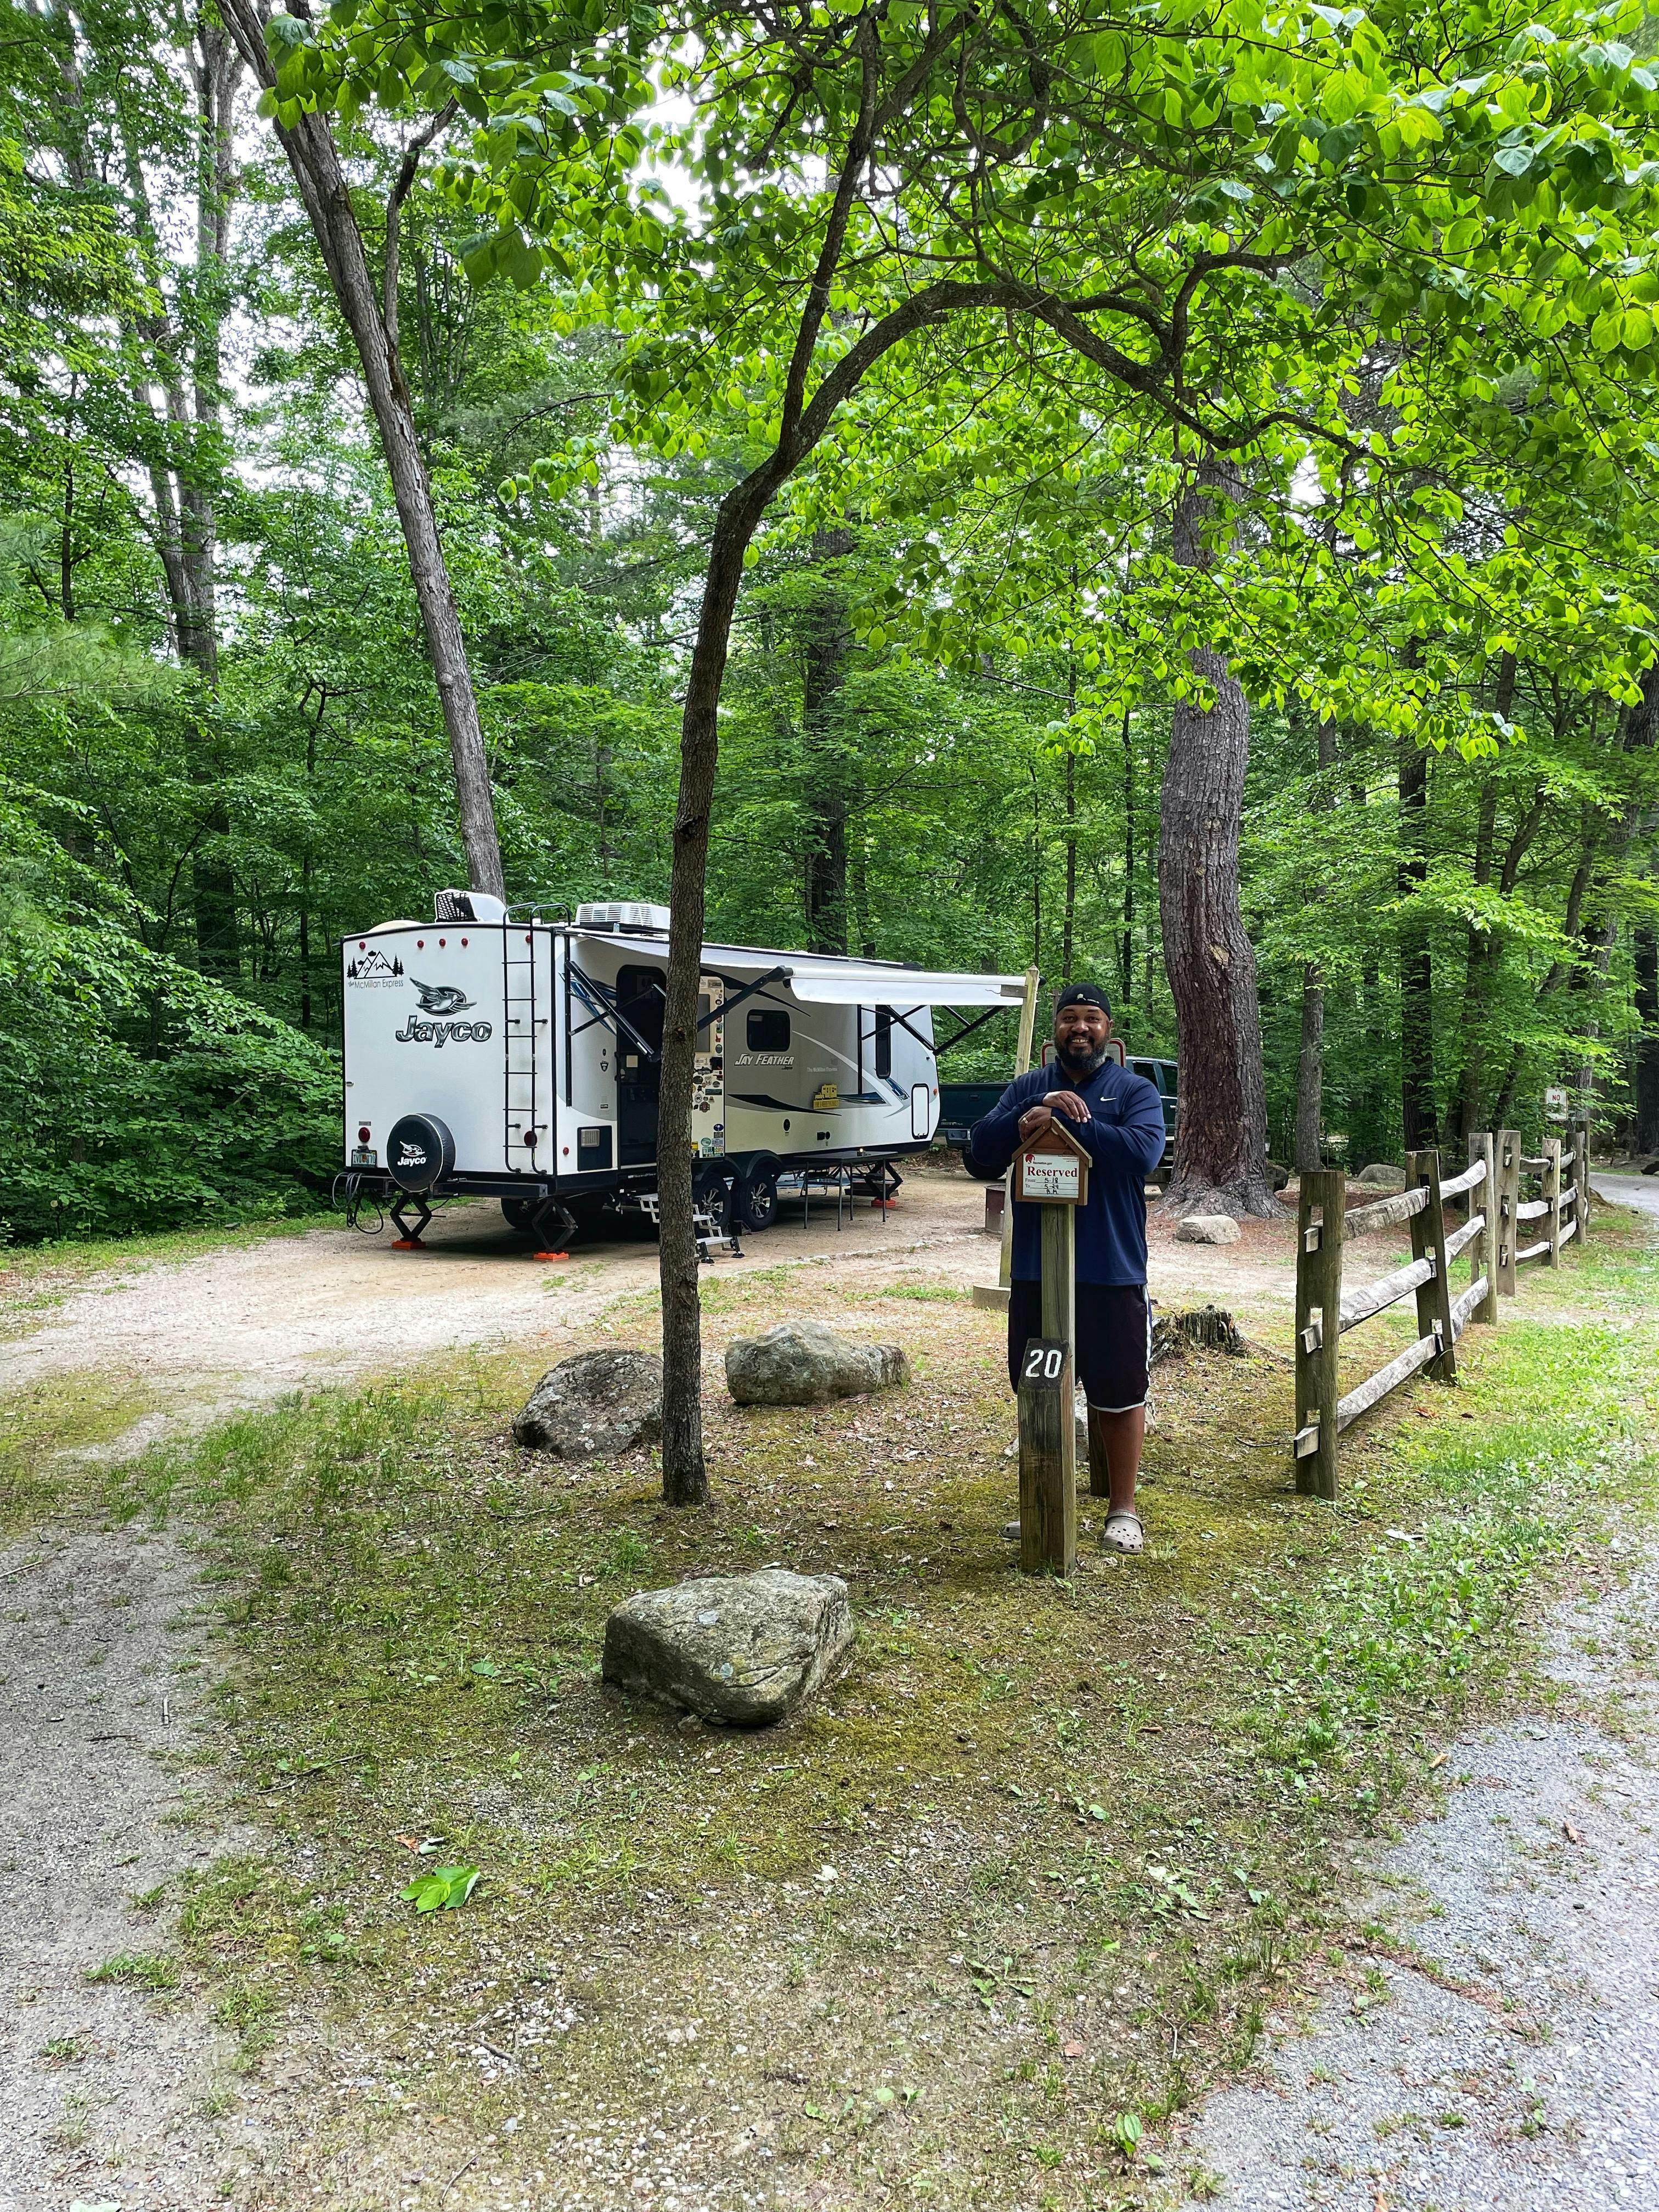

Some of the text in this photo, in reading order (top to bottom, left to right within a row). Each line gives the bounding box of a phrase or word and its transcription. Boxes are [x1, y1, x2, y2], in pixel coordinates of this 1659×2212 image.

[354, 980, 381, 989] McMillan
[382, 979, 404, 989] Express
[396, 1015, 492, 1048] Jayco
[735, 1053, 795, 1066] JAY FEATHER
[397, 1157, 426, 1167] Jayco
[1027, 1166, 1077, 1178] Reserved
[1025, 1349, 1062, 1378] 20
